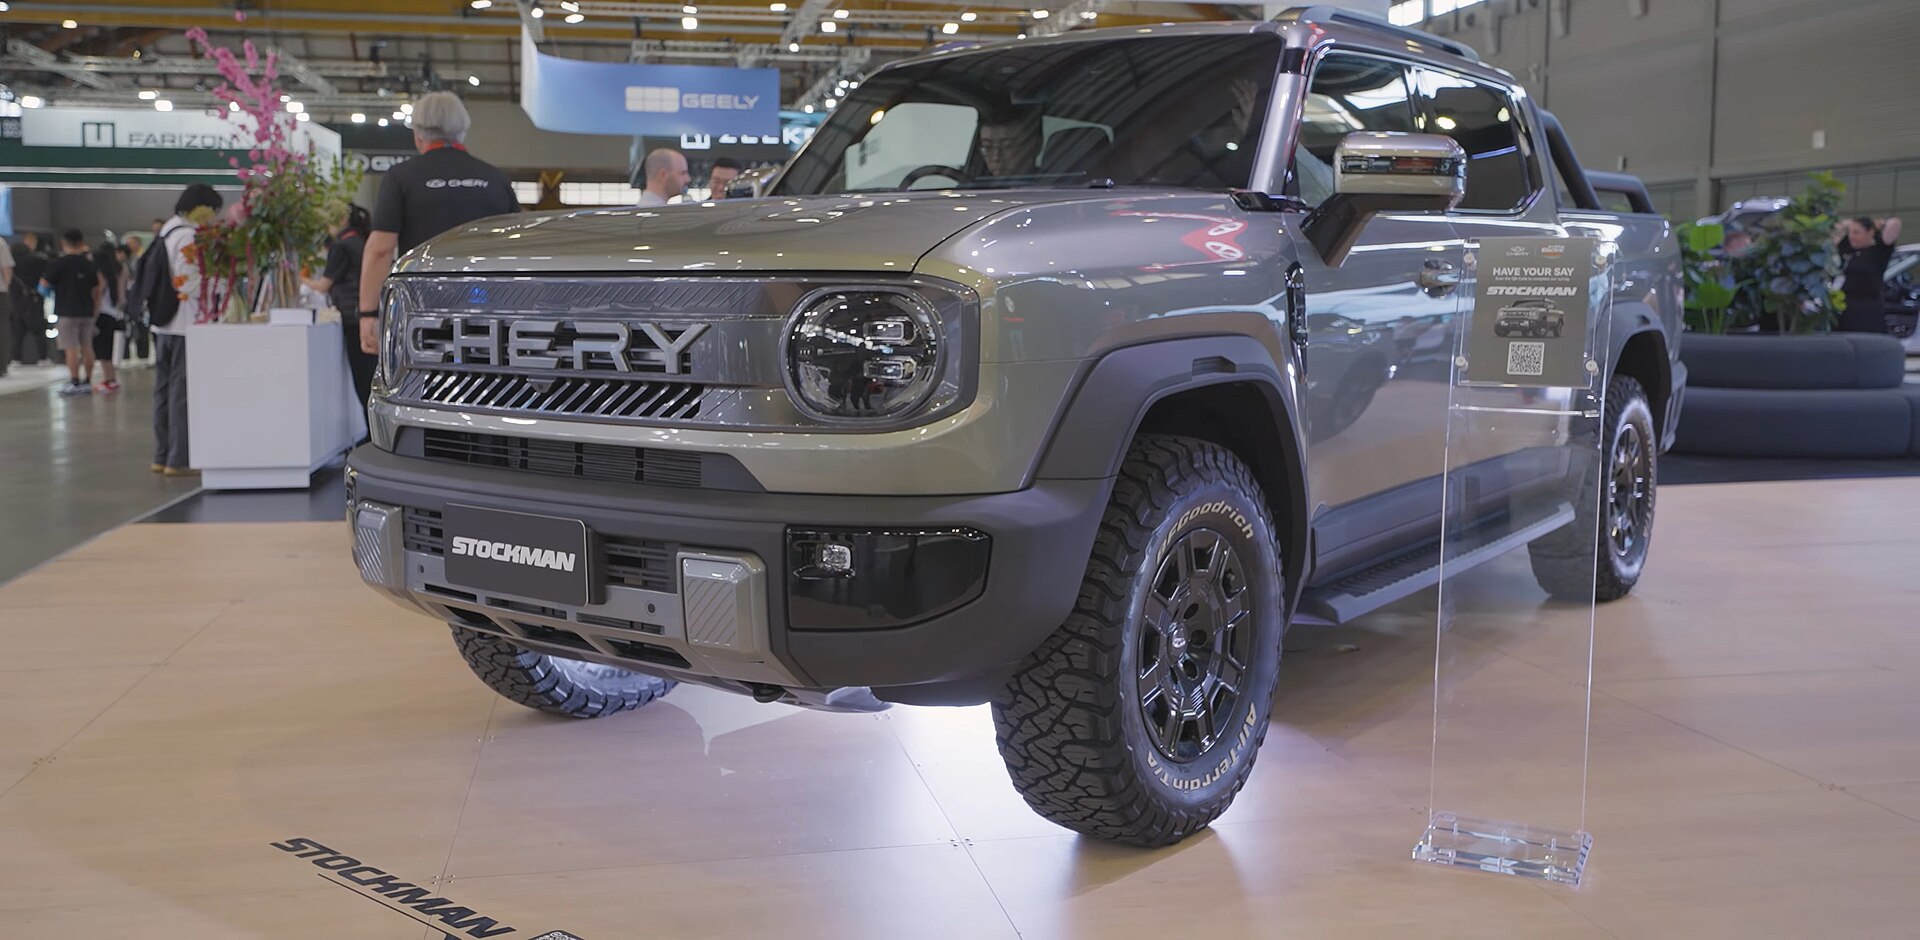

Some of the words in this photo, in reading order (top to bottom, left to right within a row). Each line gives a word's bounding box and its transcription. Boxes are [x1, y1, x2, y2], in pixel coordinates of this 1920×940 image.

[681, 93, 760, 110] GEELY
[128, 131, 233, 149] FARIZON
[447, 178, 489, 189] CHERY
[1492, 267, 1521, 276] HAVE
[1523, 267, 1552, 277] YOUR
[1554, 267, 1575, 277] SAY
[1486, 286, 1578, 296] STOCKMAN
[406, 317, 712, 375] CHERY
[1156, 500, 1255, 566] BFGoodrich
[451, 535, 576, 572] STOCKMAN
[269, 837, 517, 939] STOCKMAN
